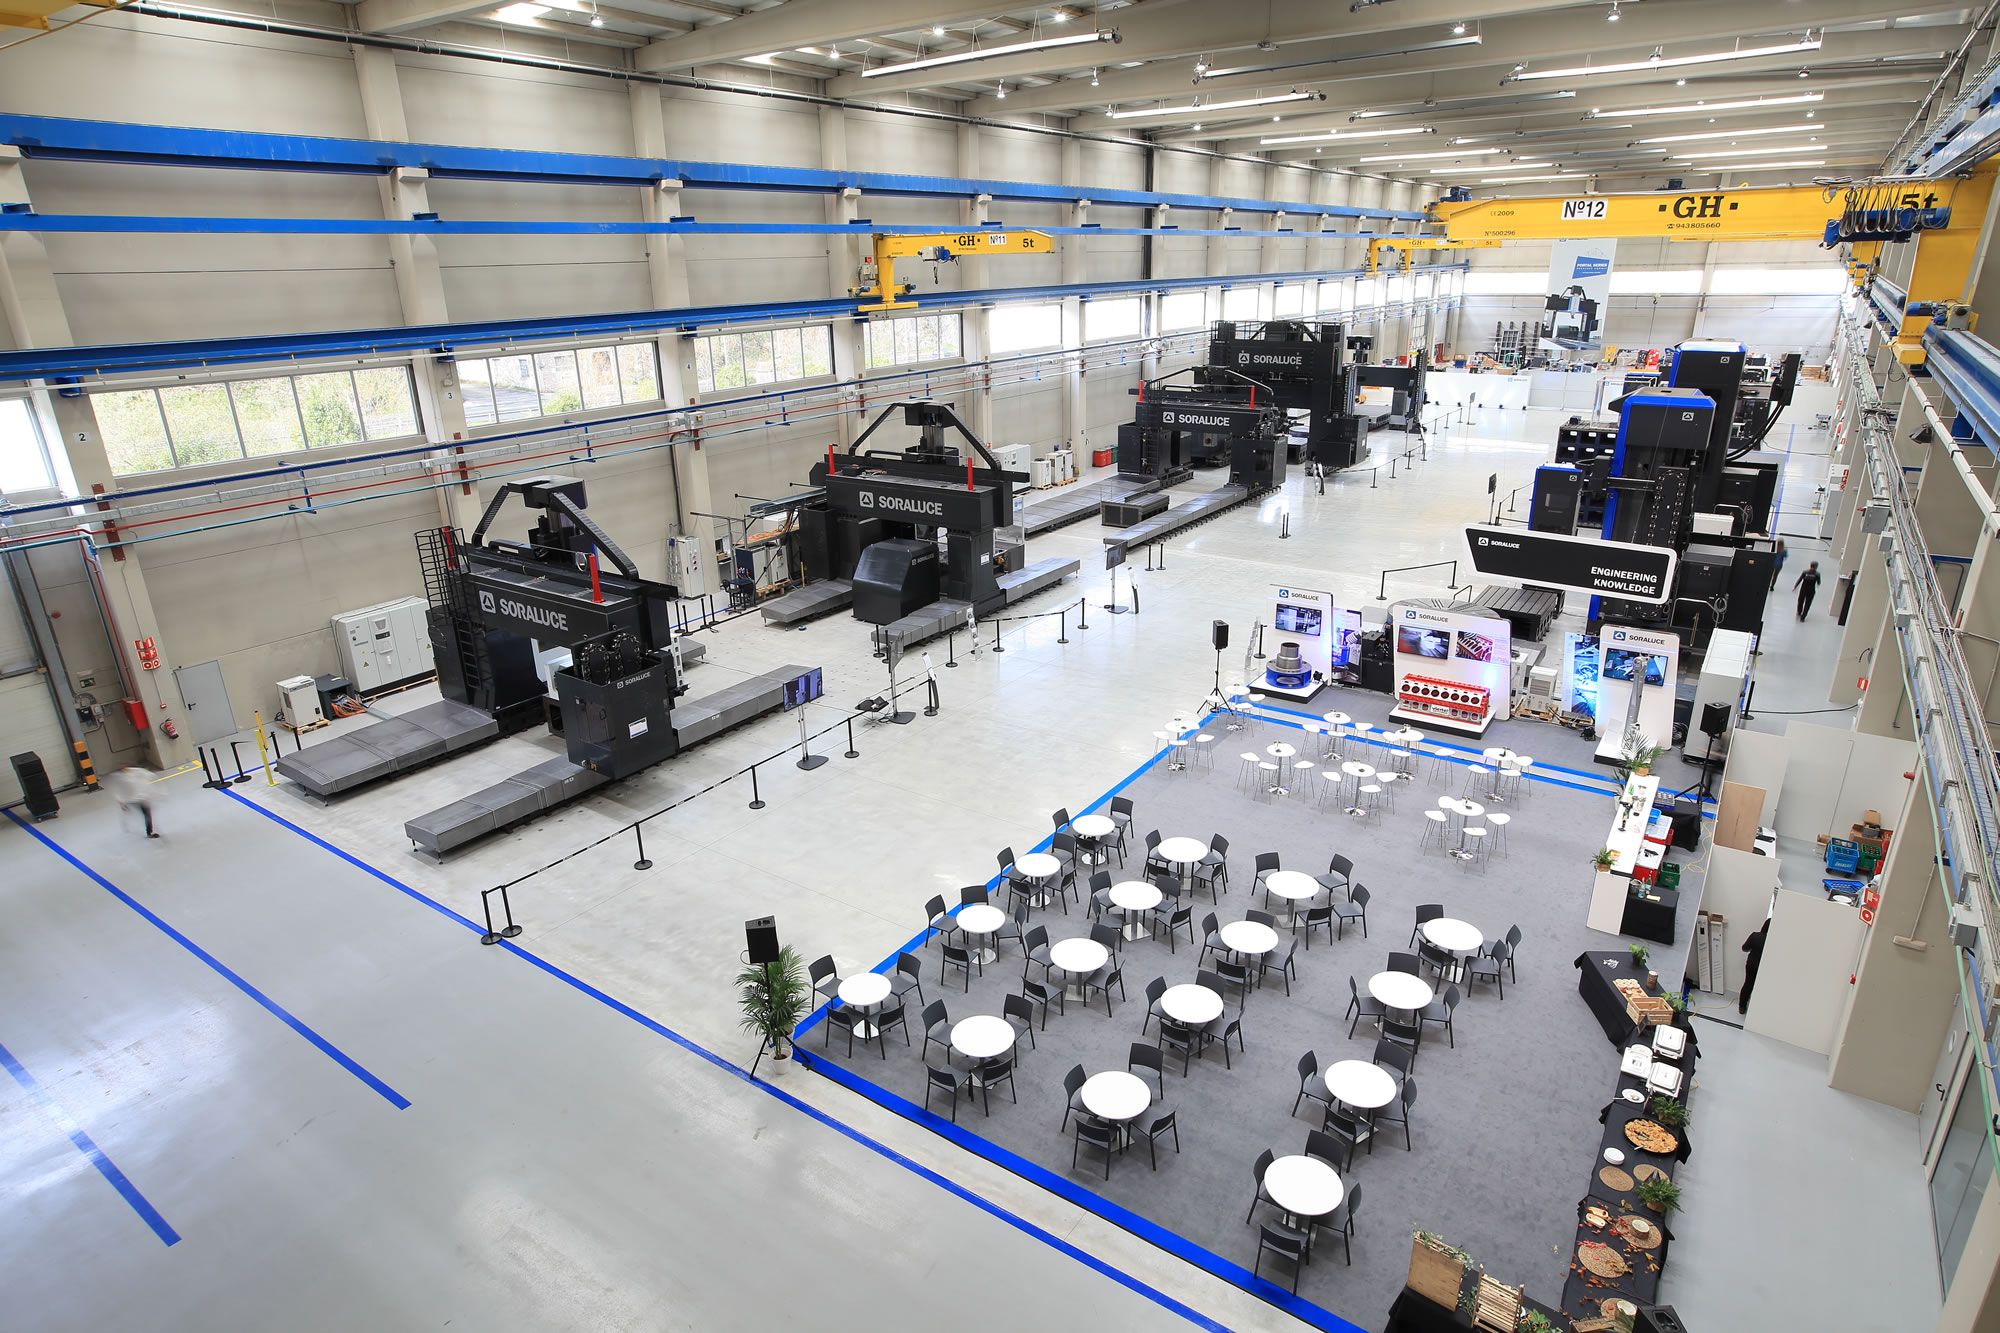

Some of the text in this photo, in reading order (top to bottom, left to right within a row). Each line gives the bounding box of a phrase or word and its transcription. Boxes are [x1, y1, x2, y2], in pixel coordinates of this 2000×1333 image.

[1673, 196, 1724, 218] GH
[958, 235, 976, 246] GH
[1022, 238, 1035, 248] 5t
[1253, 355, 1302, 365] SORALUCE
[1178, 414, 1230, 427] SORALUCE
[78, 433, 86, 441] 2
[878, 495, 943, 516] SORALUCE
[1490, 539, 1521, 549] SORALUCE
[1590, 566, 1658, 583] ENGINEERING
[1593, 578, 1656, 595] KNOWLEDGE
[1291, 592, 1320, 601] SORALUCE
[499, 598, 569, 632] SORALUCE
[1419, 613, 1449, 623] SORALUCE
[1628, 634, 1665, 645] SORALUCE
[625, 671, 651, 686] SORALUCE
